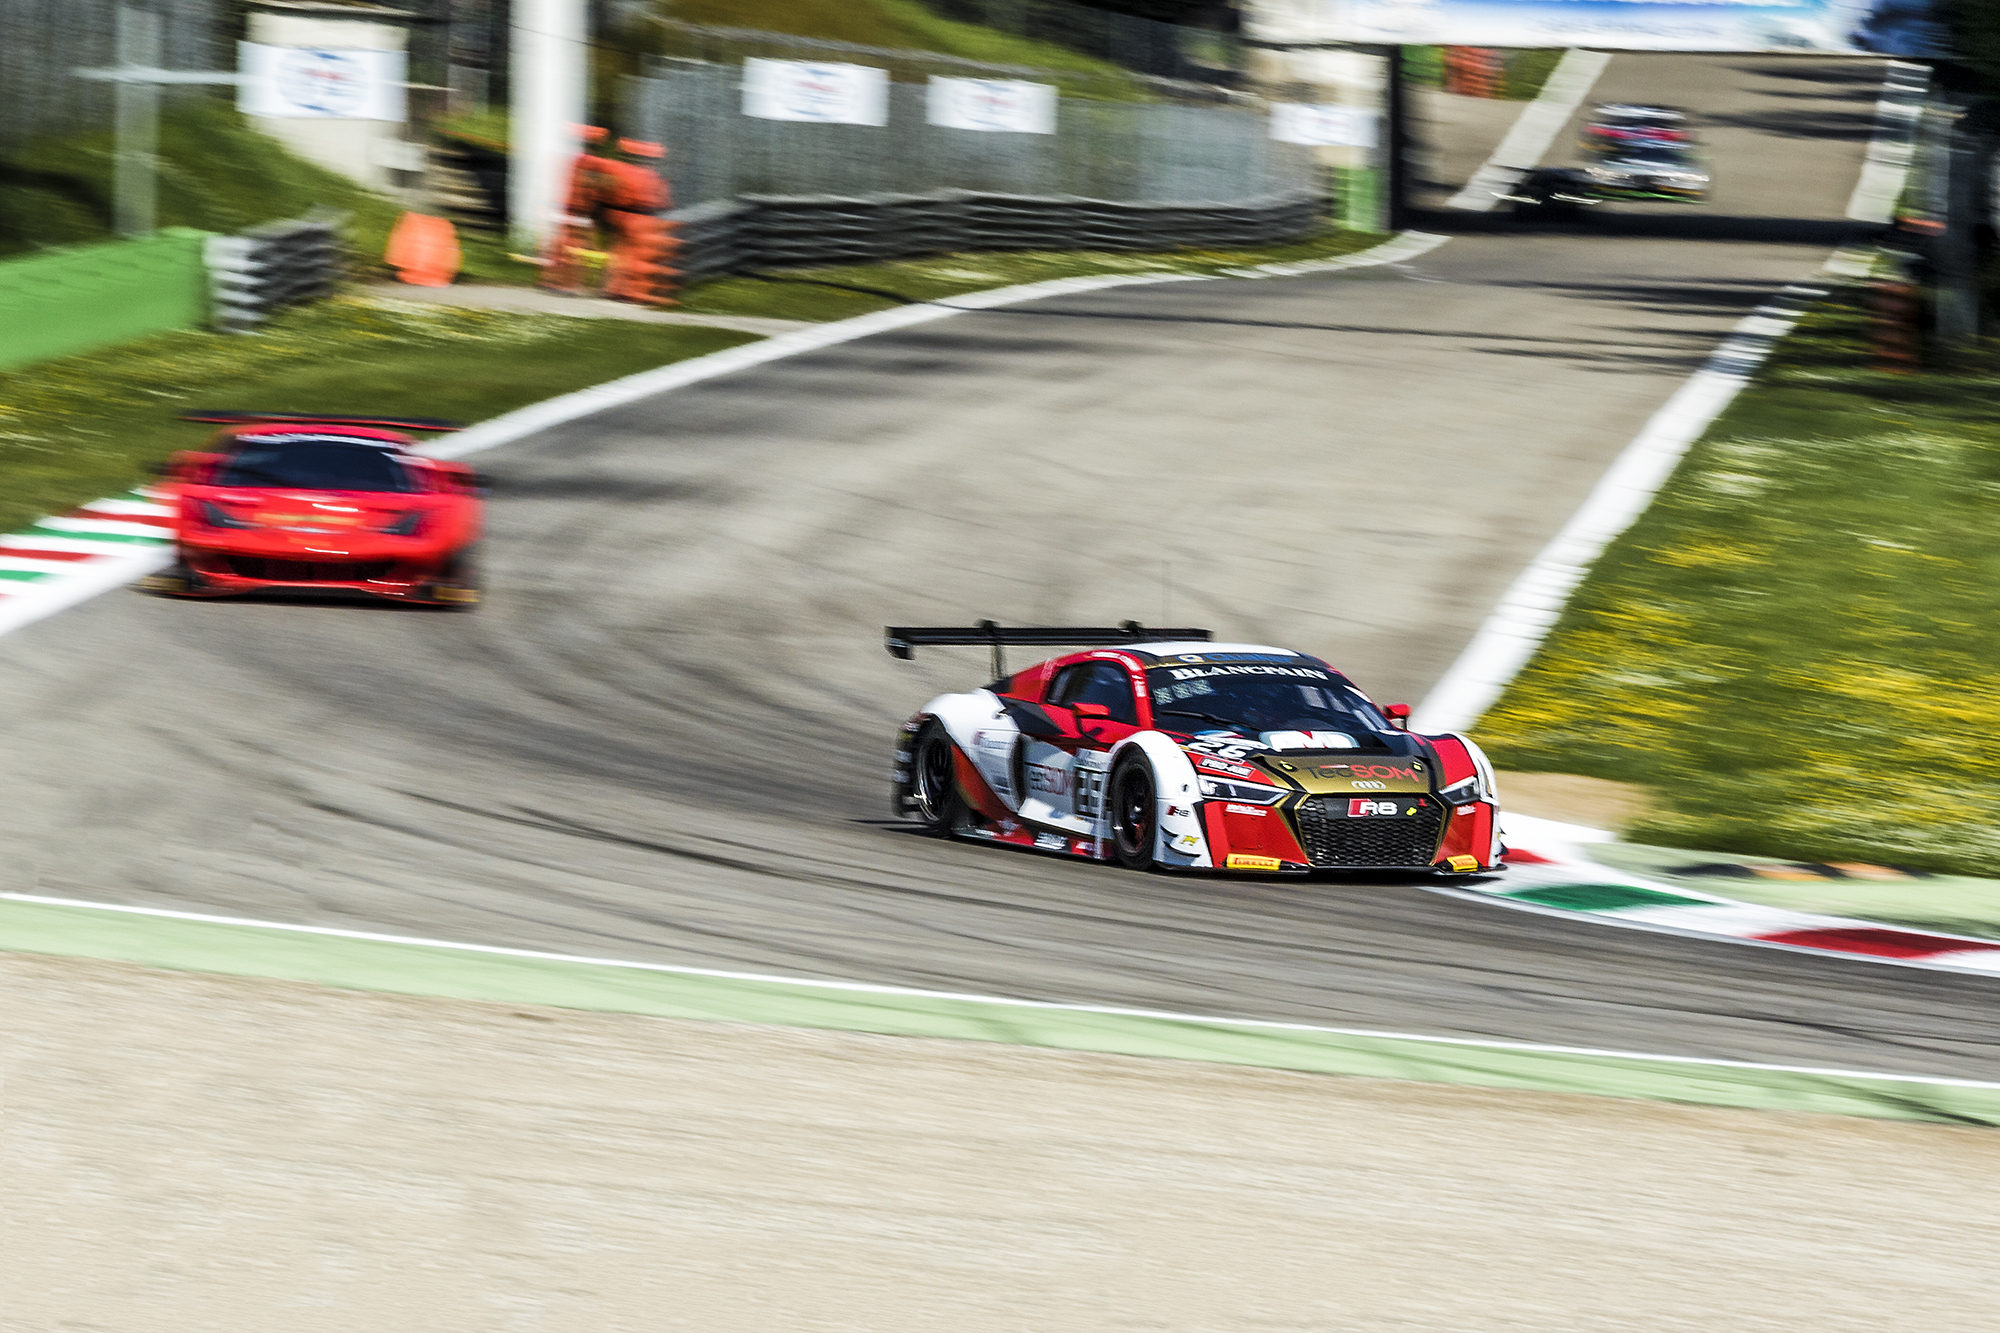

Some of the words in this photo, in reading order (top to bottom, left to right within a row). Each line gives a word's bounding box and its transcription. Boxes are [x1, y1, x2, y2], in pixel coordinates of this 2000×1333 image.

[1168, 665, 1330, 680] BLANCPAIN
[1302, 764, 1420, 782] TecSOM
[1355, 800, 1399, 817] R8
